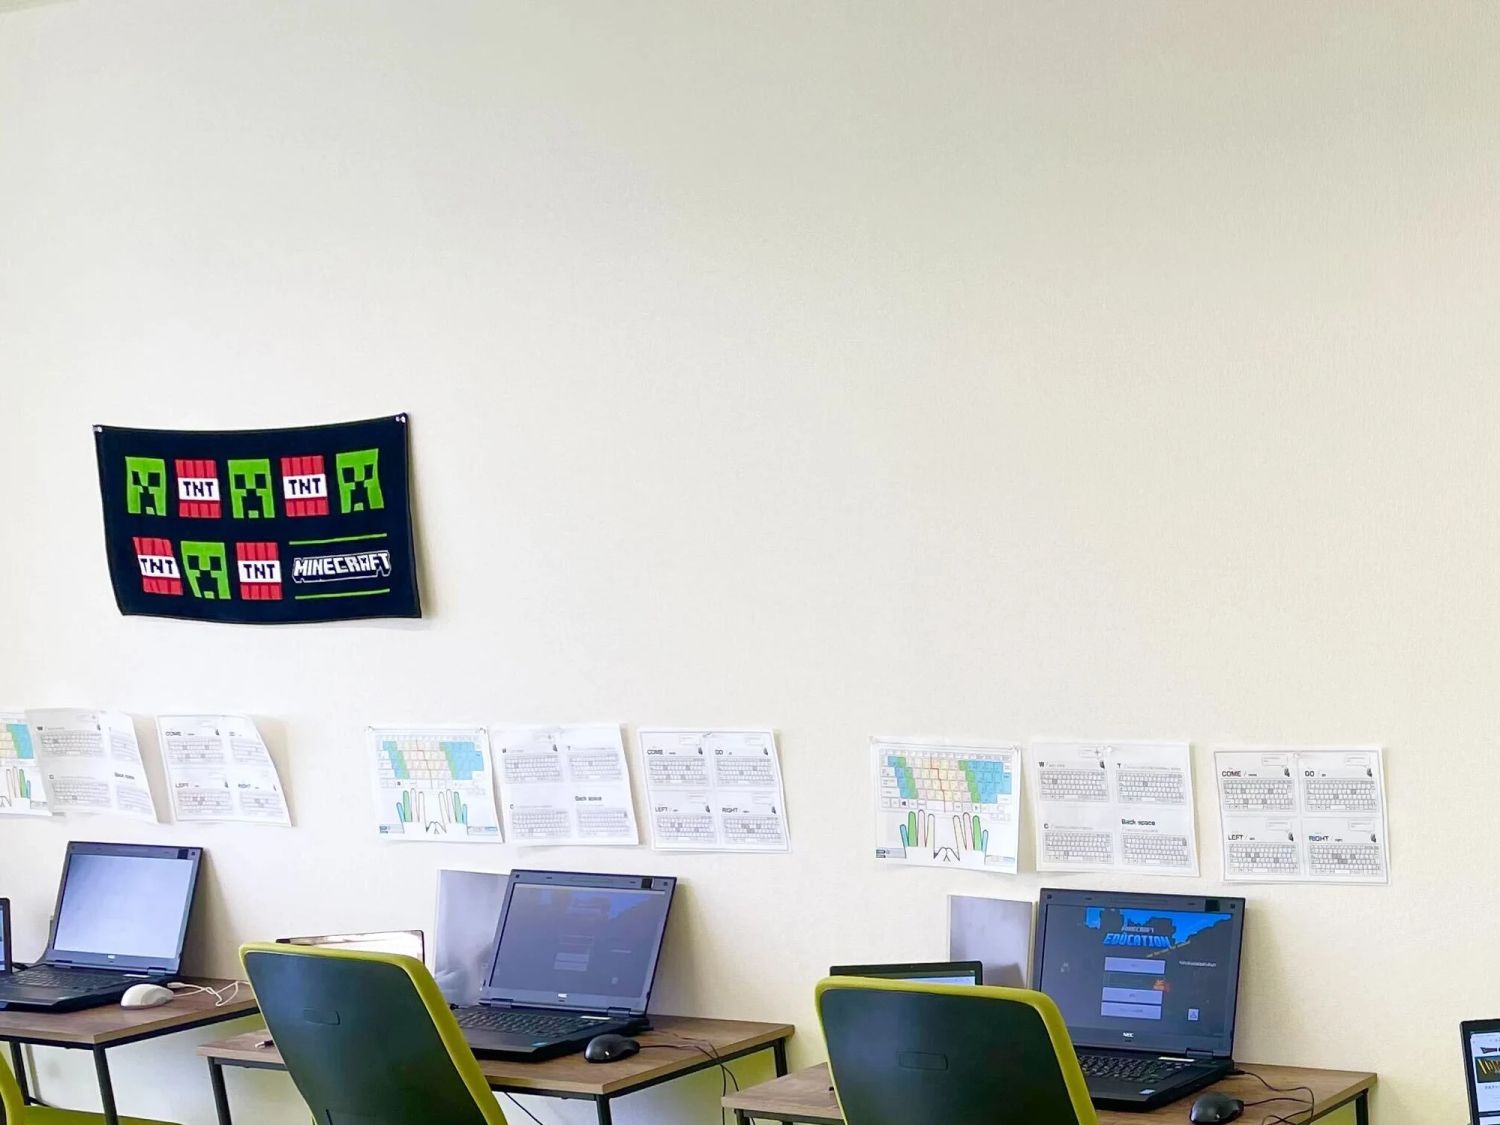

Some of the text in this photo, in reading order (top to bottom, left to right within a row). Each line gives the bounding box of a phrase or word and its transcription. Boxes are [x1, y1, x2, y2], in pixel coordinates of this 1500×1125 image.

[182, 480, 215, 497] TNT
[287, 477, 322, 494] TNT
[140, 558, 174, 575] TNT
[243, 563, 275, 580] TNT
[292, 551, 391, 583] MINECRAFT
[1103, 933, 1172, 948] EDUCATION
